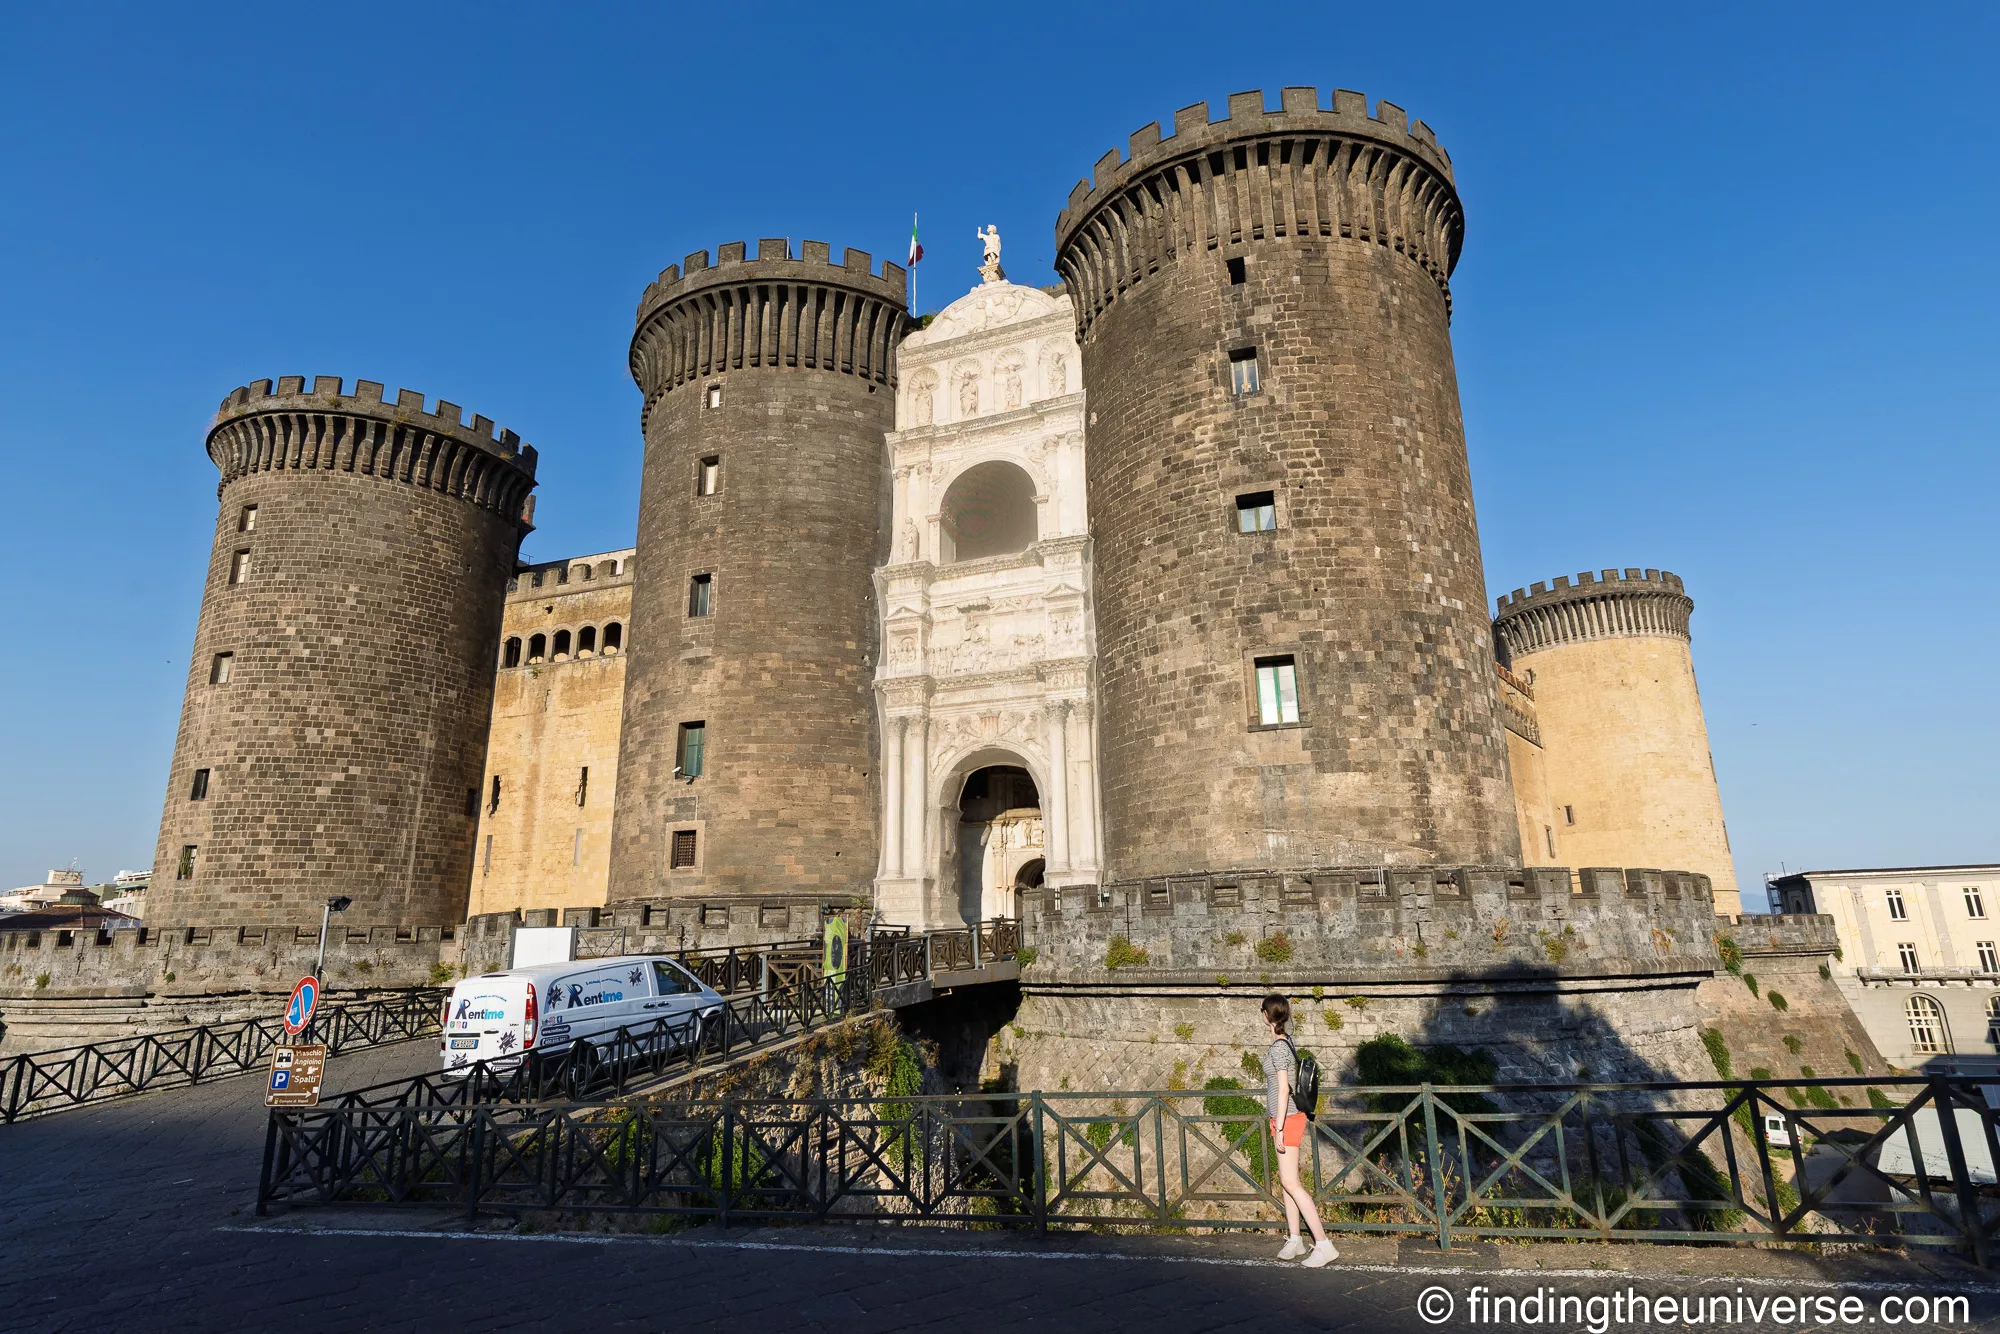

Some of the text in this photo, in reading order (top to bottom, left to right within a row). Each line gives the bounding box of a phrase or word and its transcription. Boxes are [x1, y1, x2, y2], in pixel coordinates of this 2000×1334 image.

[565, 984, 623, 1009] Rentime
[455, 999, 505, 1020] Rentime
[294, 1058, 322, 1066] Angioino
[275, 1073, 286, 1087] P
